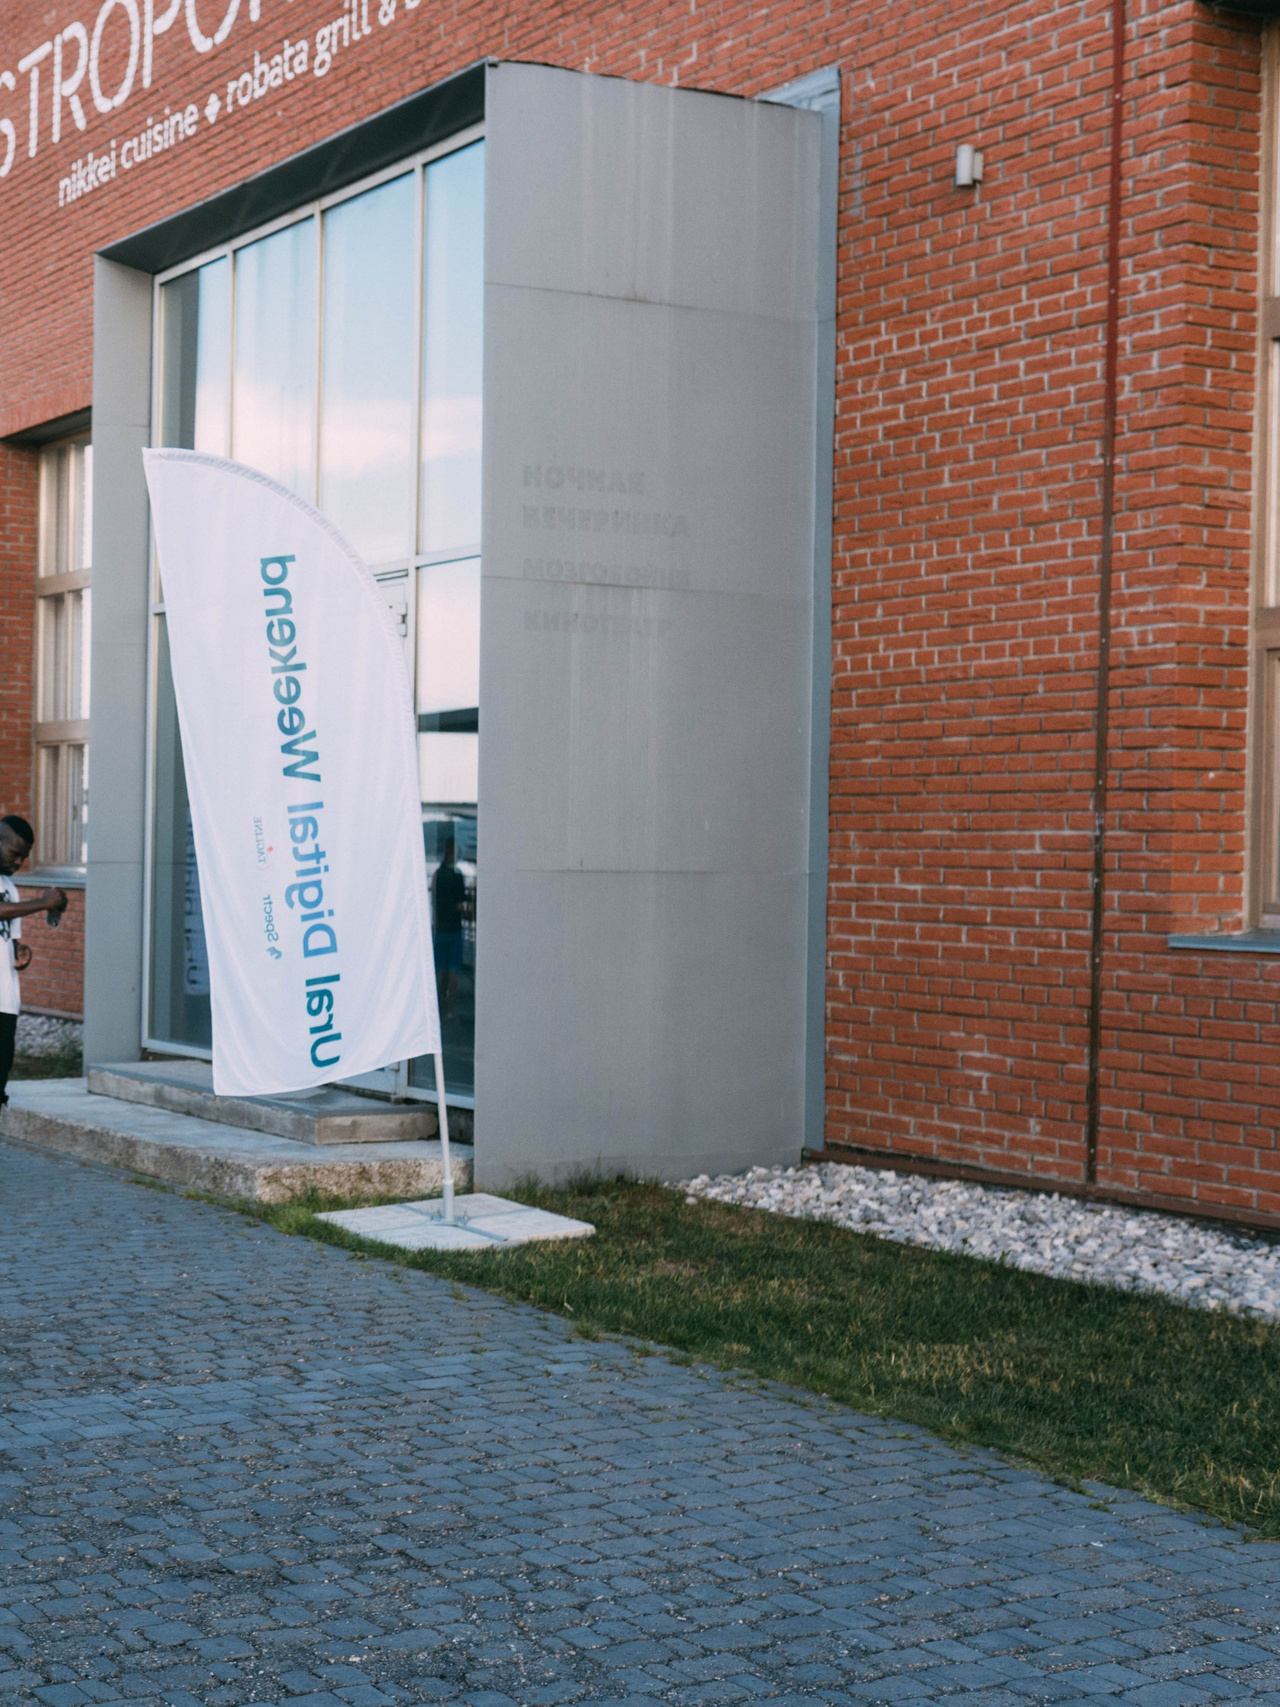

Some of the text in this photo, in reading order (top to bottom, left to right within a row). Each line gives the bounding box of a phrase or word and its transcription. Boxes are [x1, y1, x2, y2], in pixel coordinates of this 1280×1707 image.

[58, 139, 118, 207] nikkei
[119, 103, 199, 169] cuisine
[226, 39, 310, 113] robata
[313, 0, 373, 78] grill
